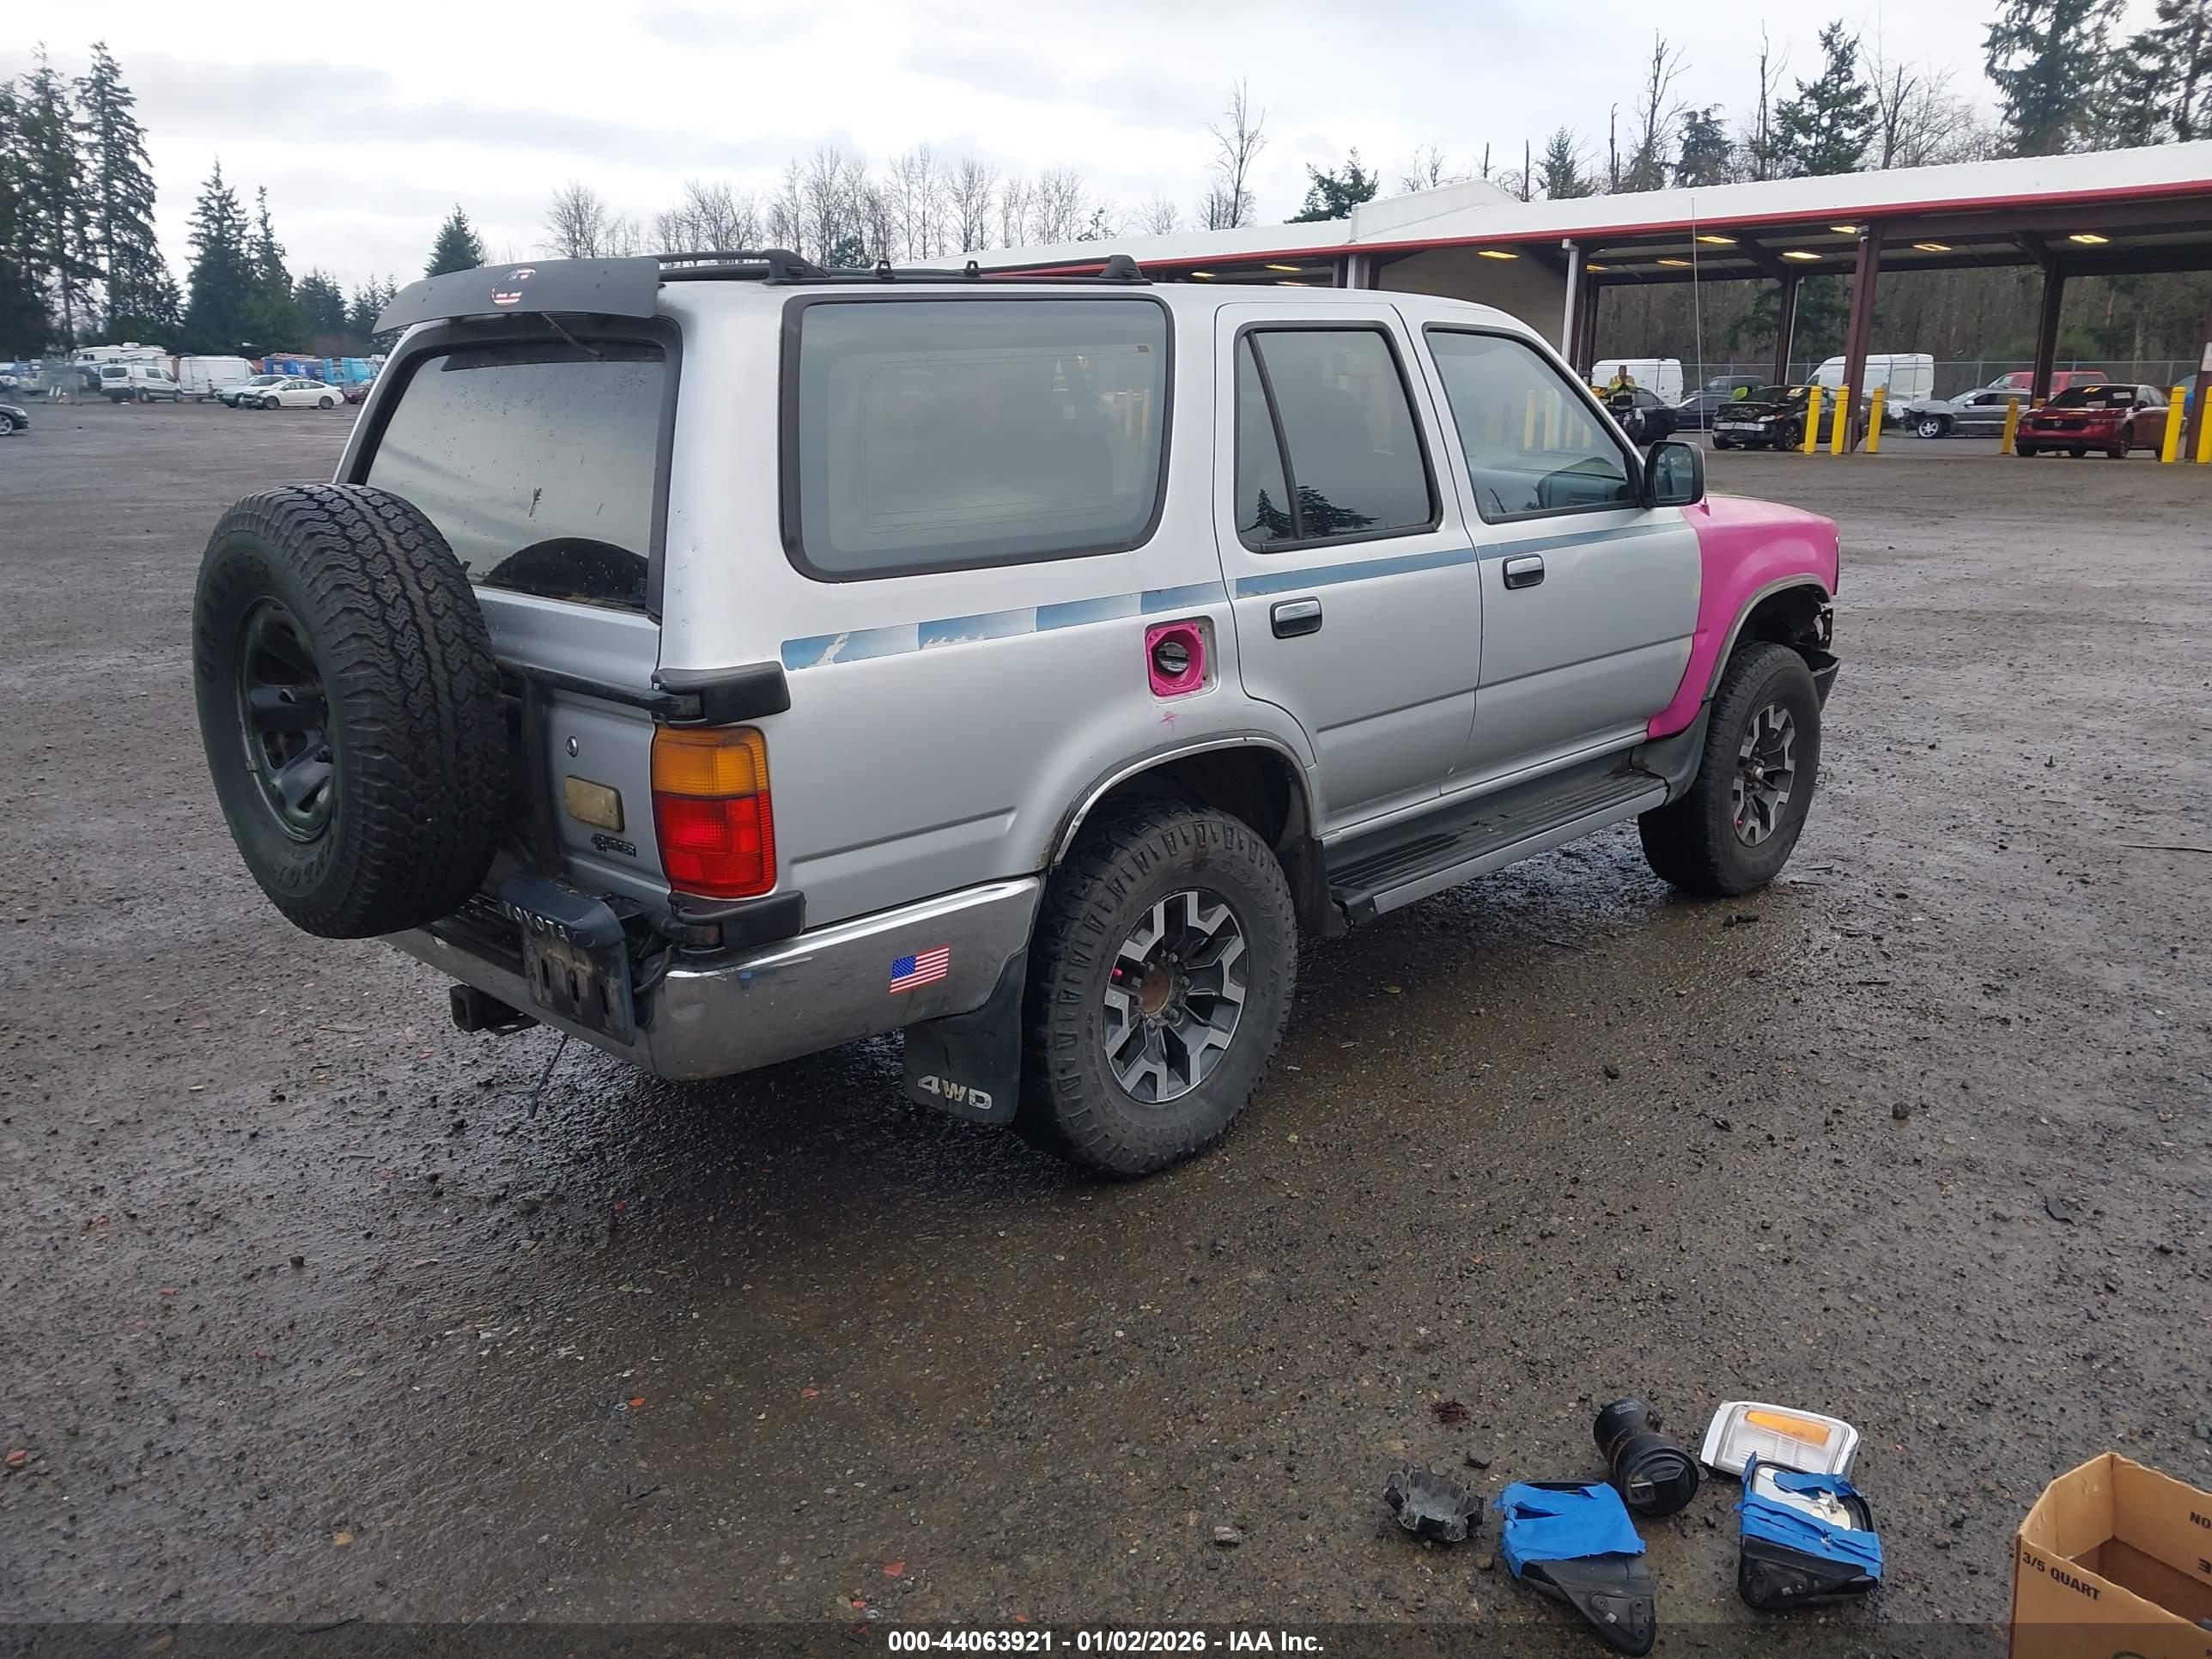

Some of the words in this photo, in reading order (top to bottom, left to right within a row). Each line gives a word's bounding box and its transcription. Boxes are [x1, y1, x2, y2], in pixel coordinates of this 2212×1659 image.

[501, 900, 570, 943] TOYOTA
[917, 1075, 993, 1109] 4WD
[2022, 1552, 2046, 1573] 3/5
[2051, 1566, 2102, 1601] QUART
